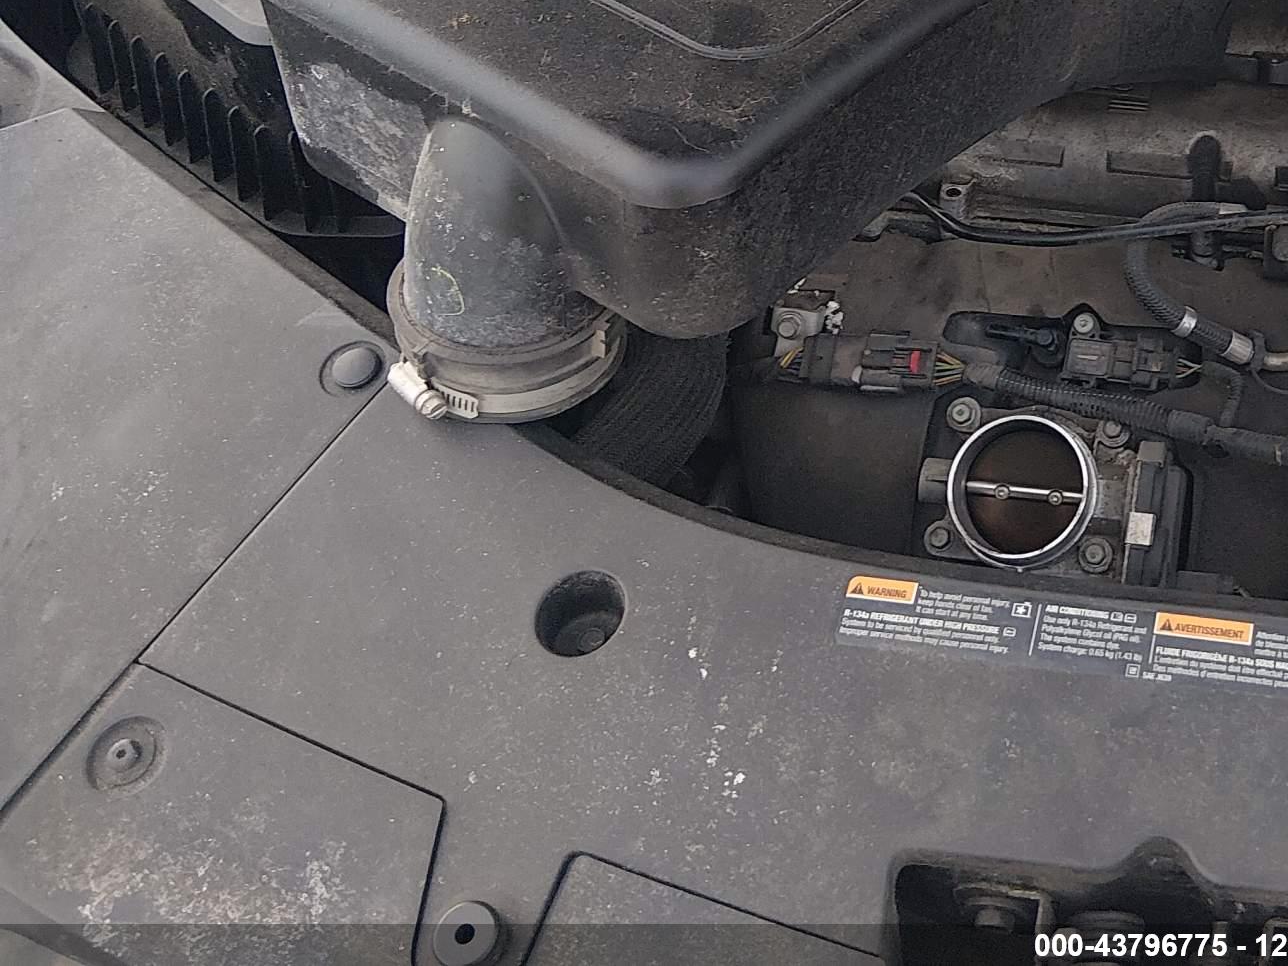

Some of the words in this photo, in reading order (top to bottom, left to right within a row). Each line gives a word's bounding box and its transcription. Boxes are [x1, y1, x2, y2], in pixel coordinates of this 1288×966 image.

[867, 586, 907, 599] WARNING
[1046, 605, 1059, 613] AIR
[1059, 607, 1109, 619] CONDITIONING
[844, 609, 869, 619] R-134a
[870, 612, 918, 625] REFRIGERANT
[919, 618, 944, 628] UNDER
[944, 621, 962, 630] HIGH
[963, 623, 1000, 634] PRESSURE
[1175, 623, 1244, 639] AVERTISSEMENT
